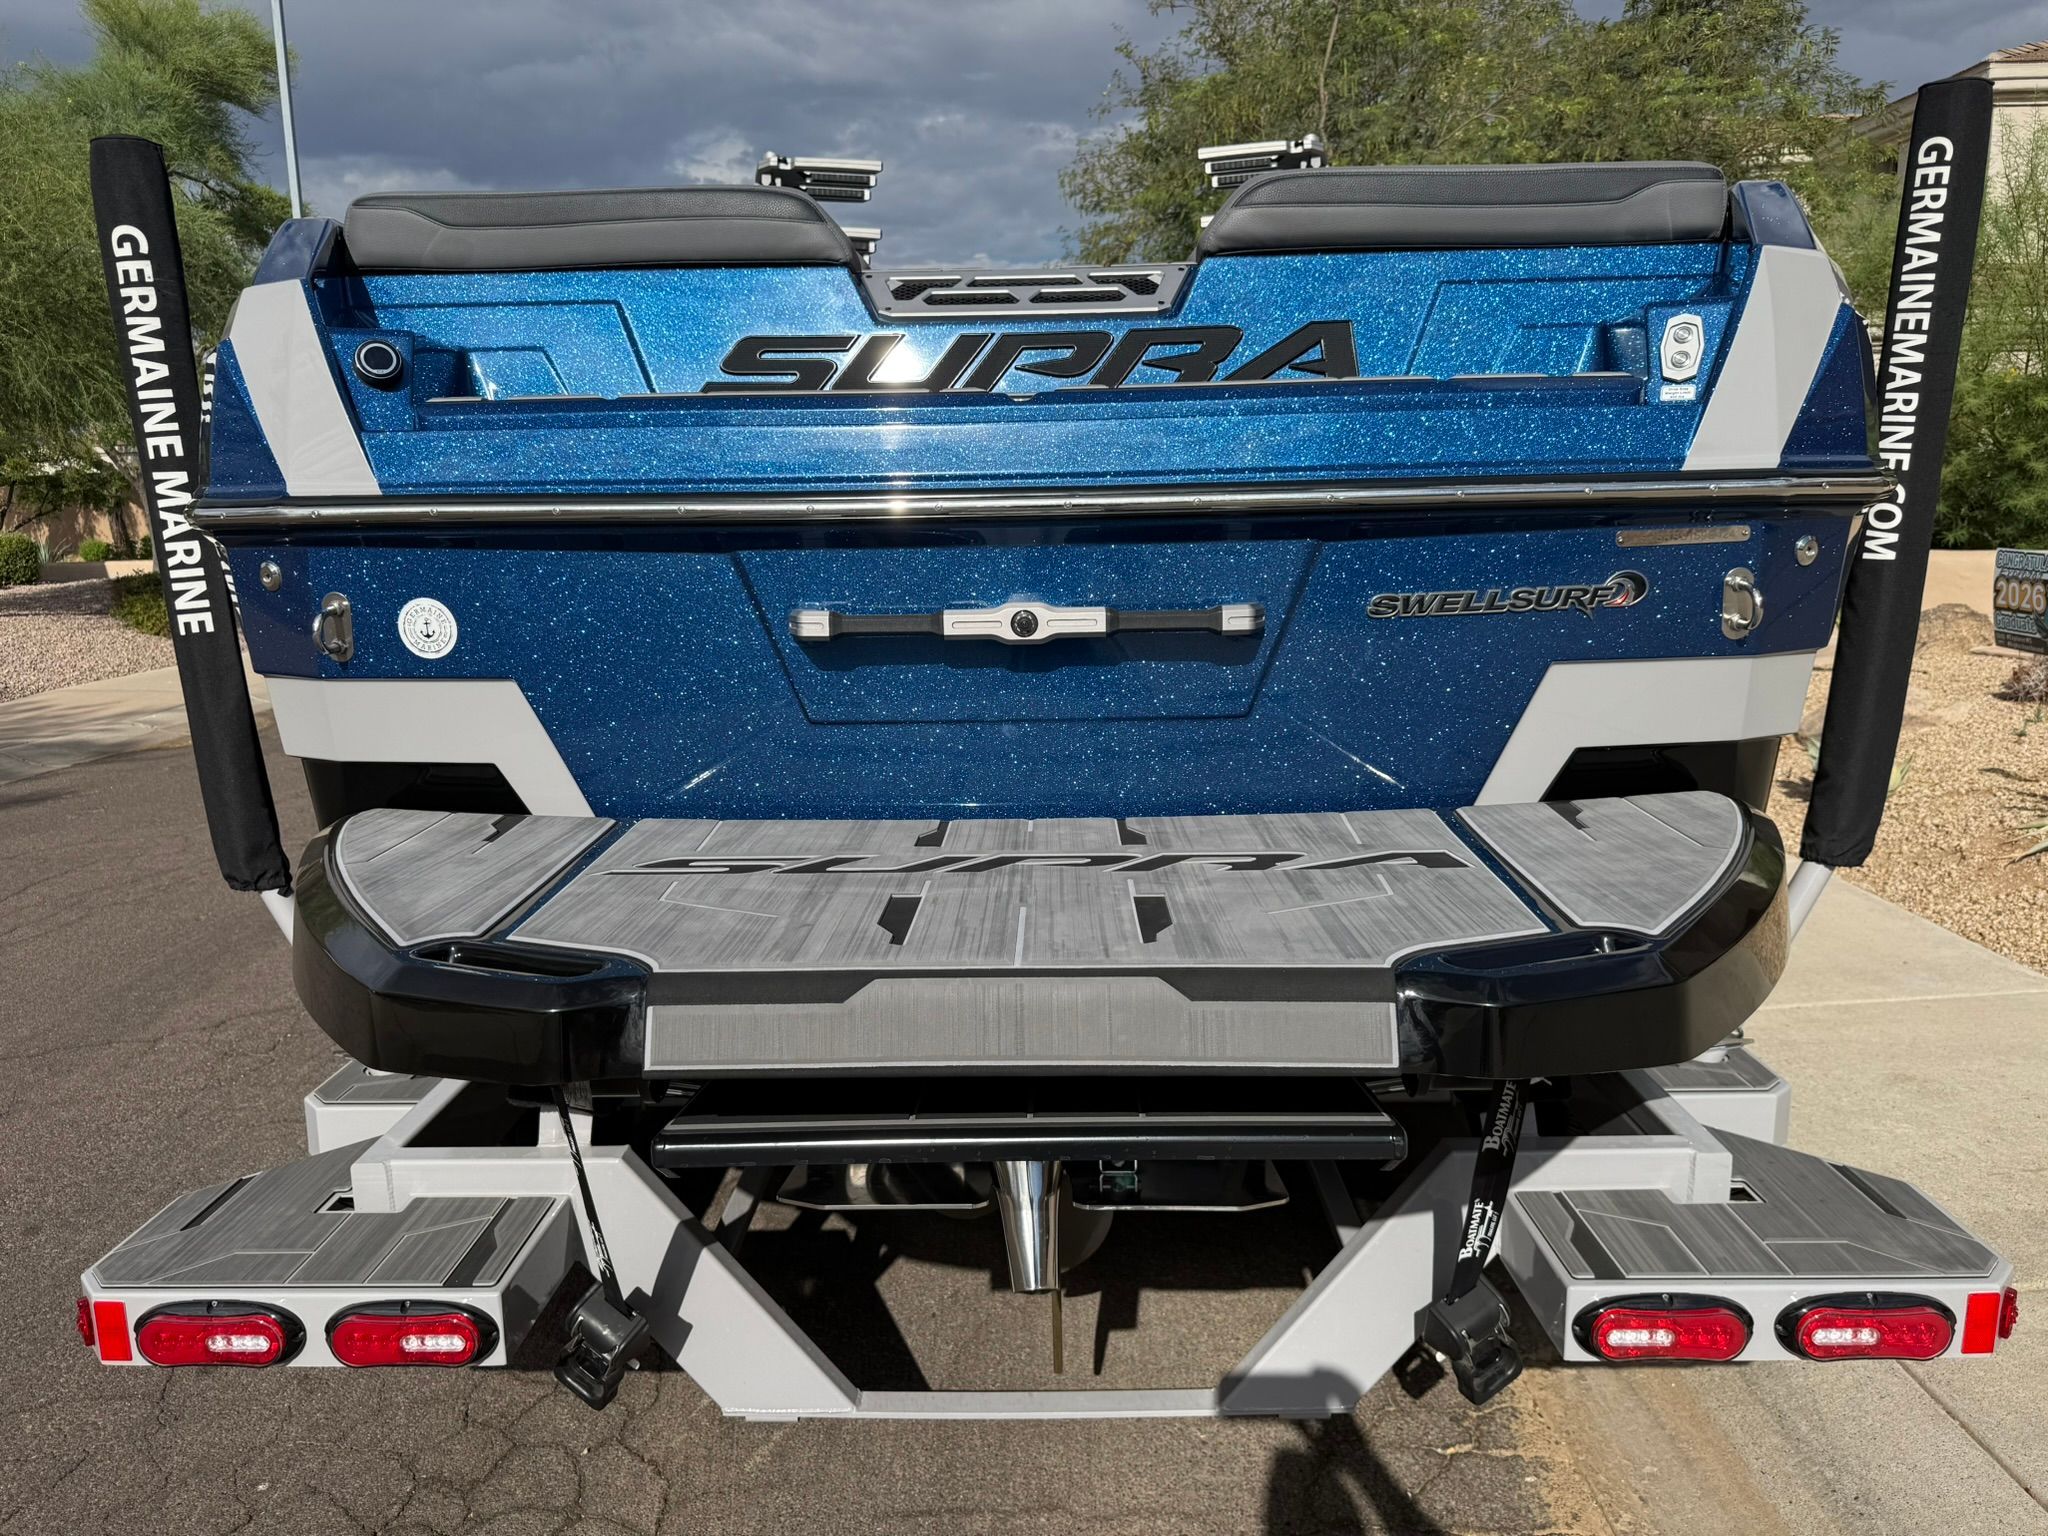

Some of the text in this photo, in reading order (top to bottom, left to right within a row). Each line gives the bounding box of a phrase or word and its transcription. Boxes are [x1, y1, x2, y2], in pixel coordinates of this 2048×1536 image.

[700, 320, 1360, 393] SUPRA
[1862, 135, 1954, 560] GERMAINEMARINEOM
[111, 224, 214, 636] GERMAINE MARINE
[406, 606, 447, 625] GERMAINE
[1367, 584, 1618, 621] SWELLSURF
[1995, 578, 2045, 614] 2026
[413, 639, 447, 650] MARINE
[589, 849, 1476, 876] SUPRA
[1482, 1079, 1517, 1152] BOATMATE
[1458, 1197, 1485, 1263] BOATMATE
